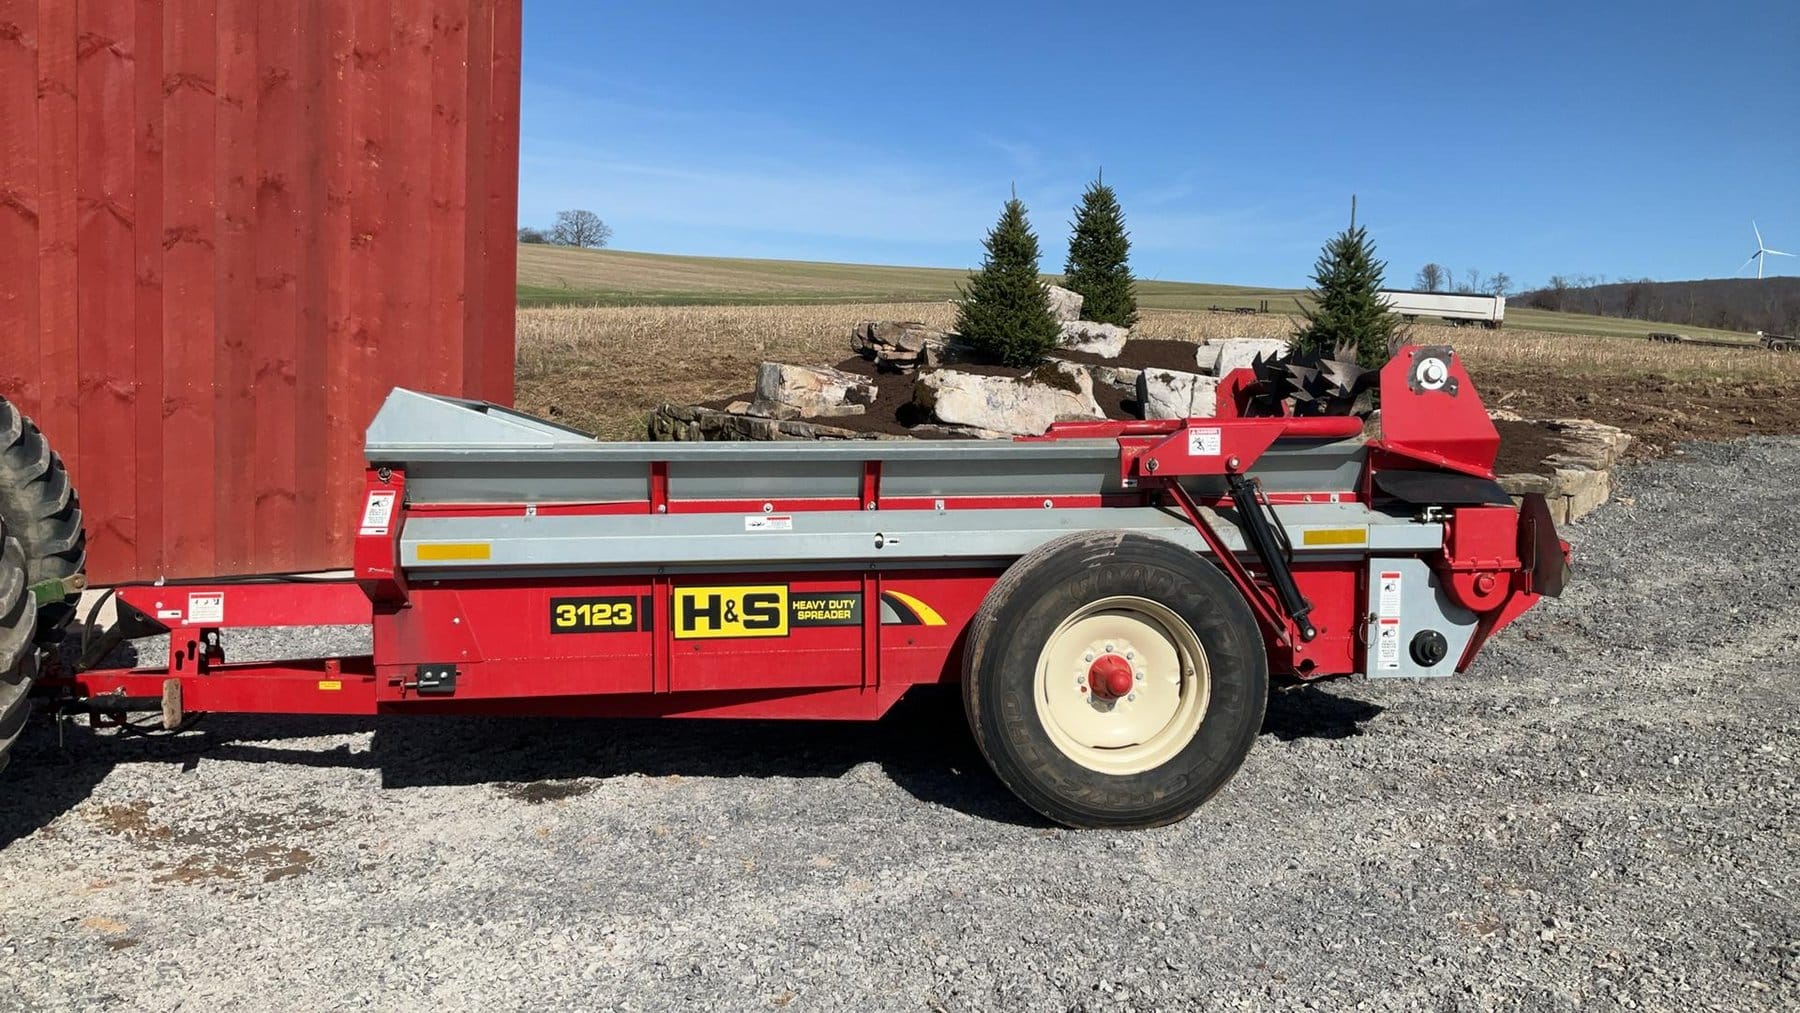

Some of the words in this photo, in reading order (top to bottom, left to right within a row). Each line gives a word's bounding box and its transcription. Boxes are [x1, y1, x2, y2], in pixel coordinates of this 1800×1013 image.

[682, 593, 780, 631] H&S
[792, 601, 826, 609] HEAVY
[828, 600, 855, 608] DUTY
[556, 603, 632, 626] 3123
[797, 610, 851, 619] SPREADER
